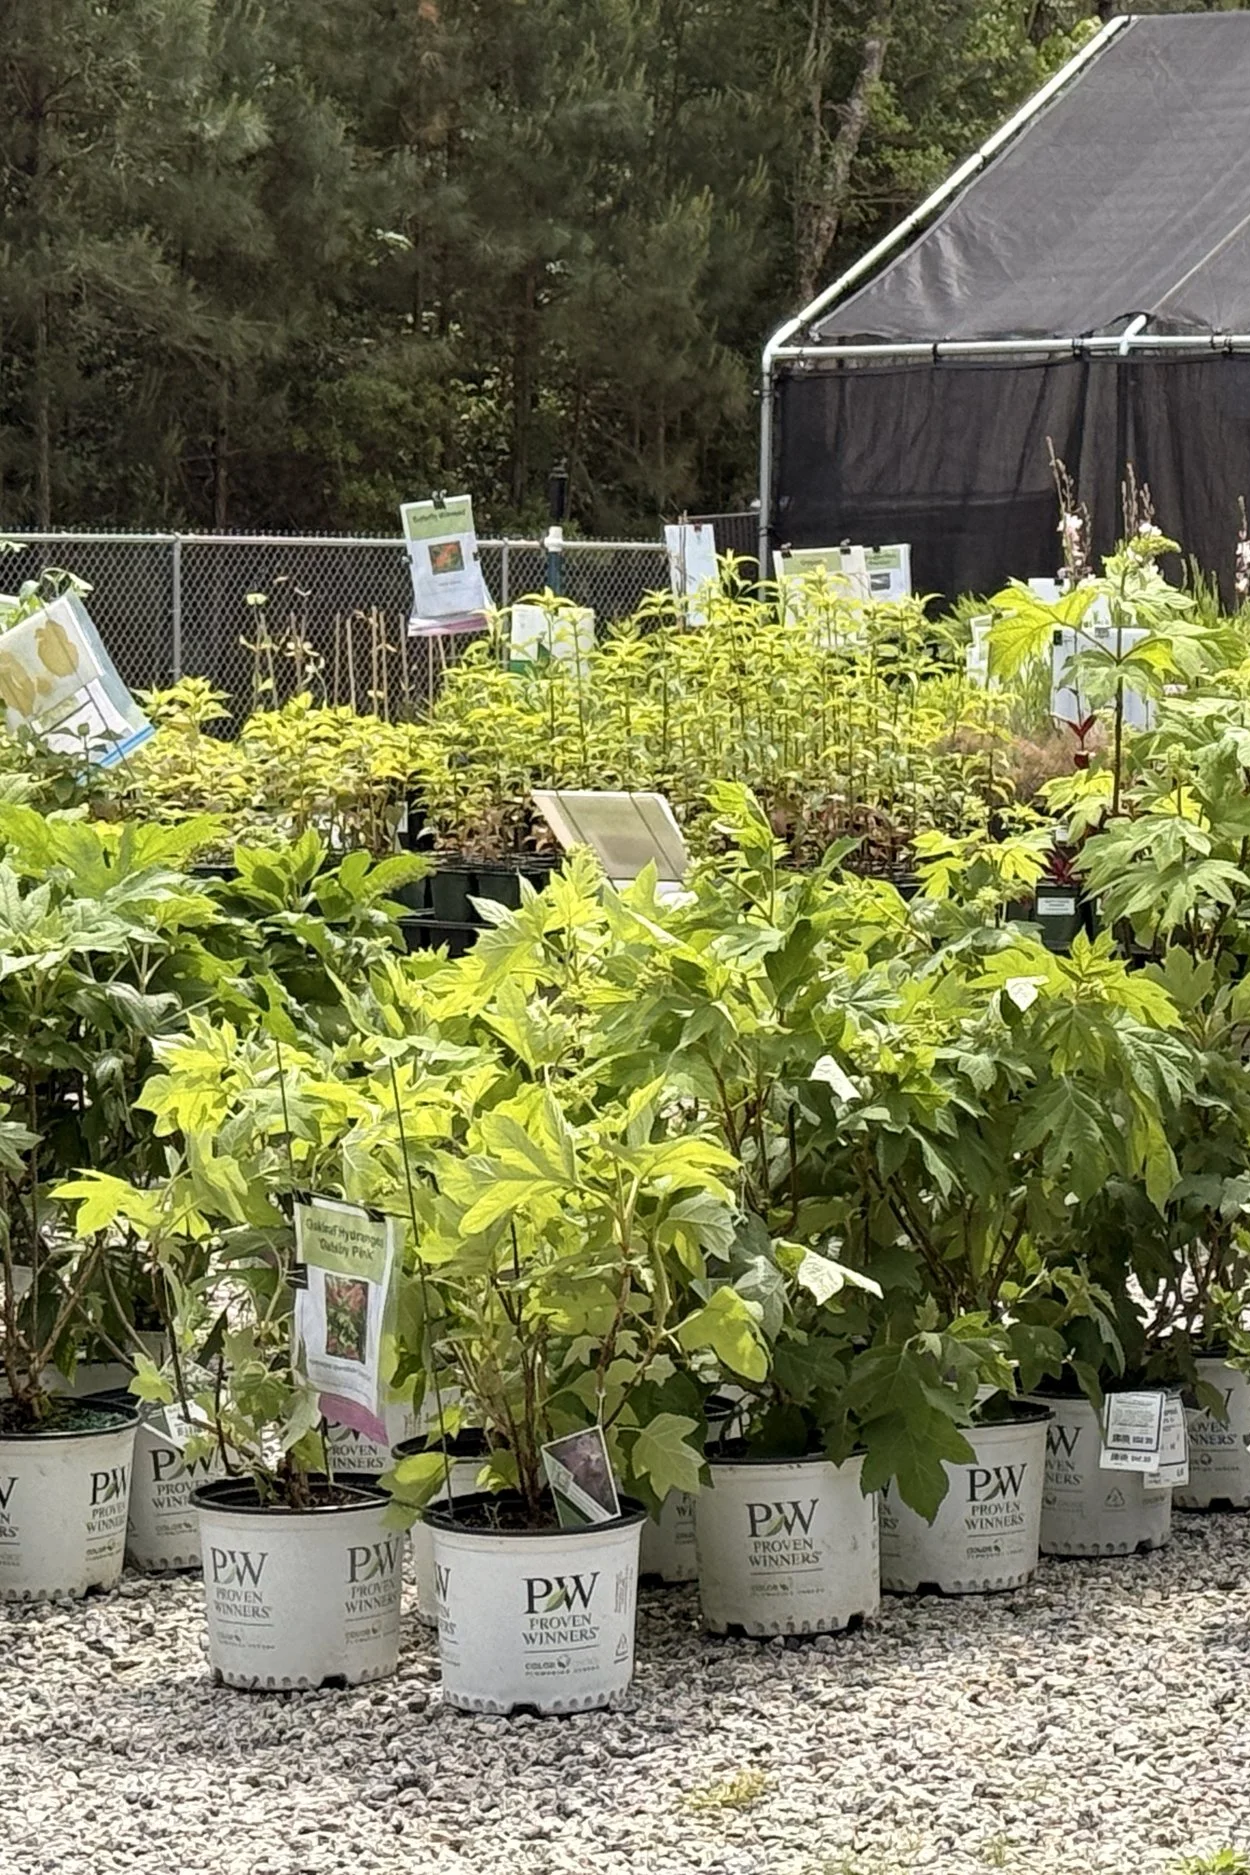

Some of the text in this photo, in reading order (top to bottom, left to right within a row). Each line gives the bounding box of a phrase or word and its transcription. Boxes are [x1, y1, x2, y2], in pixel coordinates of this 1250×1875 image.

[329, 1444, 378, 1456] ROVEN
[329, 1457, 384, 1469] INNERS
[966, 1463, 1027, 1502] PW
[746, 1498, 819, 1537] PW
[971, 1502, 1020, 1516] PROVEN
[964, 1514, 1025, 1530] WINNERS
[754, 1537, 813, 1553] PROVEN
[210, 1547, 268, 1588] PW
[346, 1537, 399, 1584] PW
[749, 1551, 820, 1568] WINNERS
[216, 1587, 263, 1604] PROVEN
[522, 1571, 600, 1614] PW
[215, 1602, 271, 1619] WINNERS
[529, 1612, 592, 1631] PROVEN
[522, 1626, 598, 1646] WINNERS
